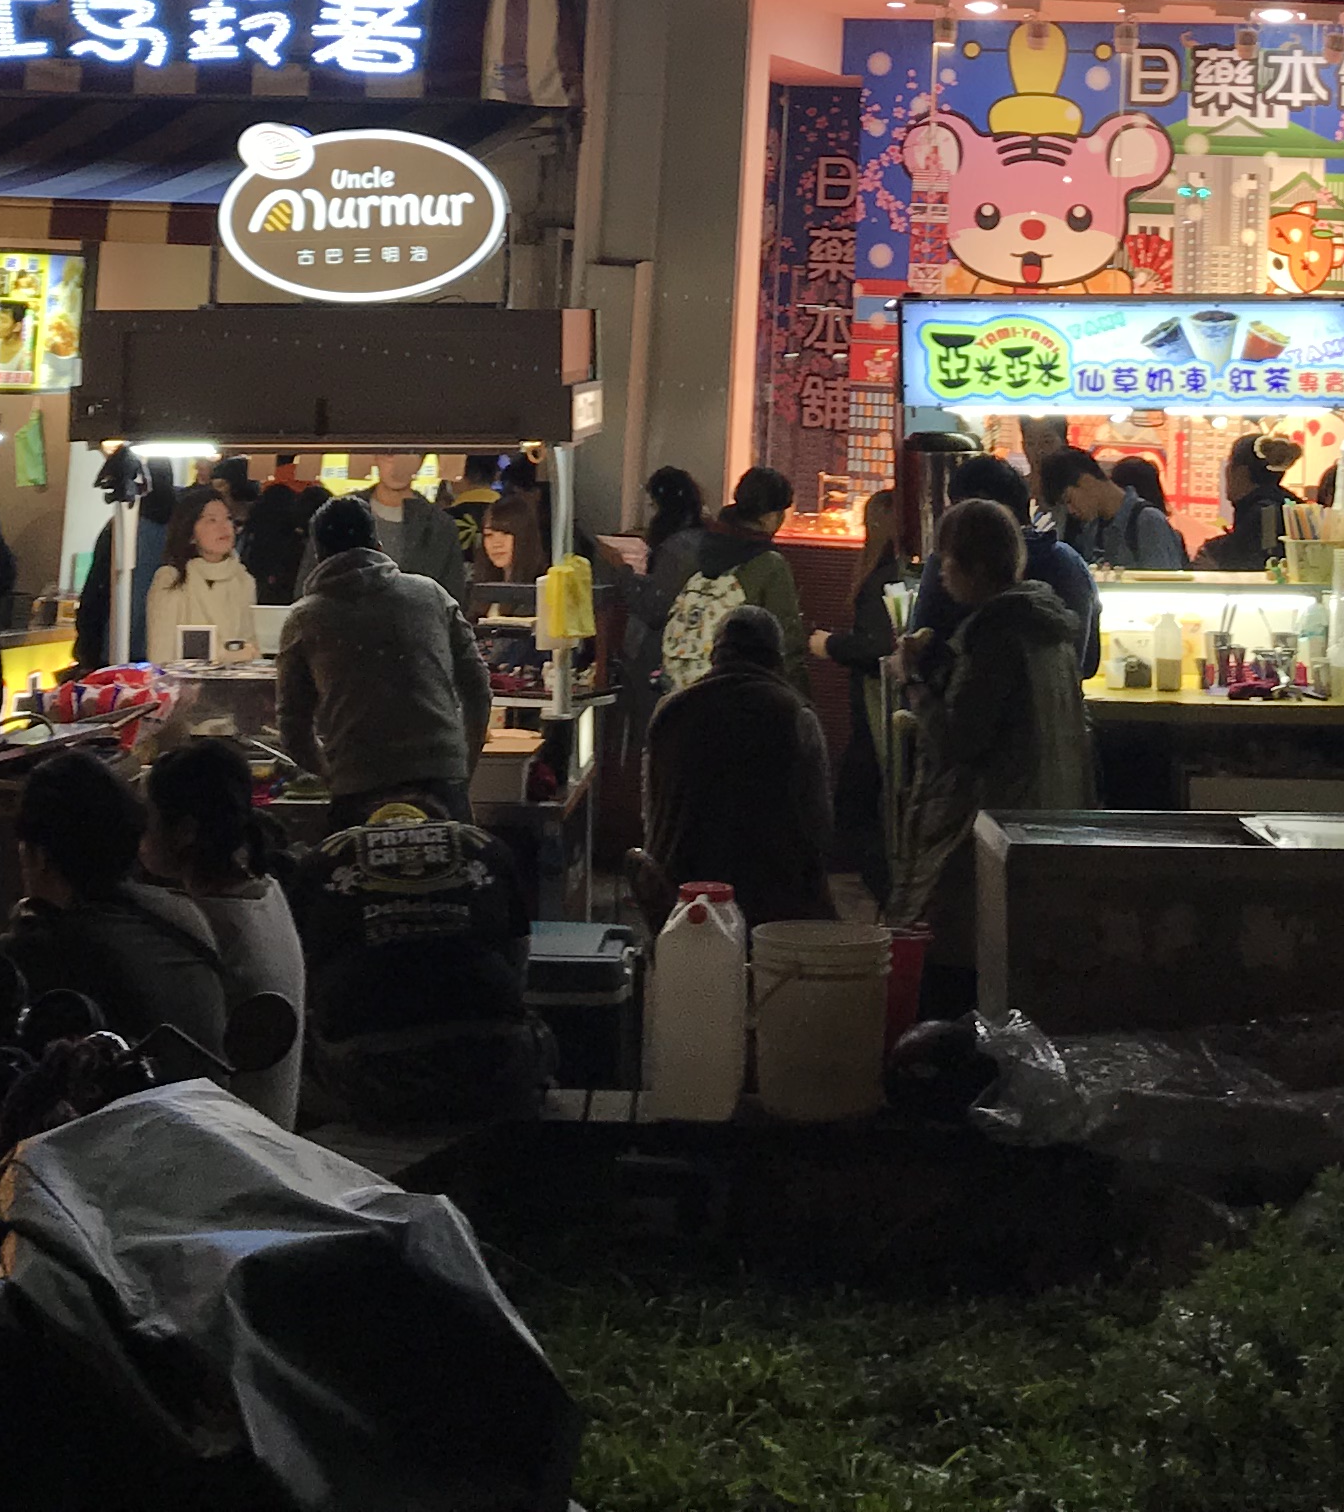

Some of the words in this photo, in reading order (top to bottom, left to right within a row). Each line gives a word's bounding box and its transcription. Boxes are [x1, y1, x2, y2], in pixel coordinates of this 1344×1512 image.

[330, 165, 396, 190] Uncle
[247, 187, 476, 233] Murmur
[296, 244, 429, 266] 古巴三明治
[801, 155, 858, 430] 日藥本舖
